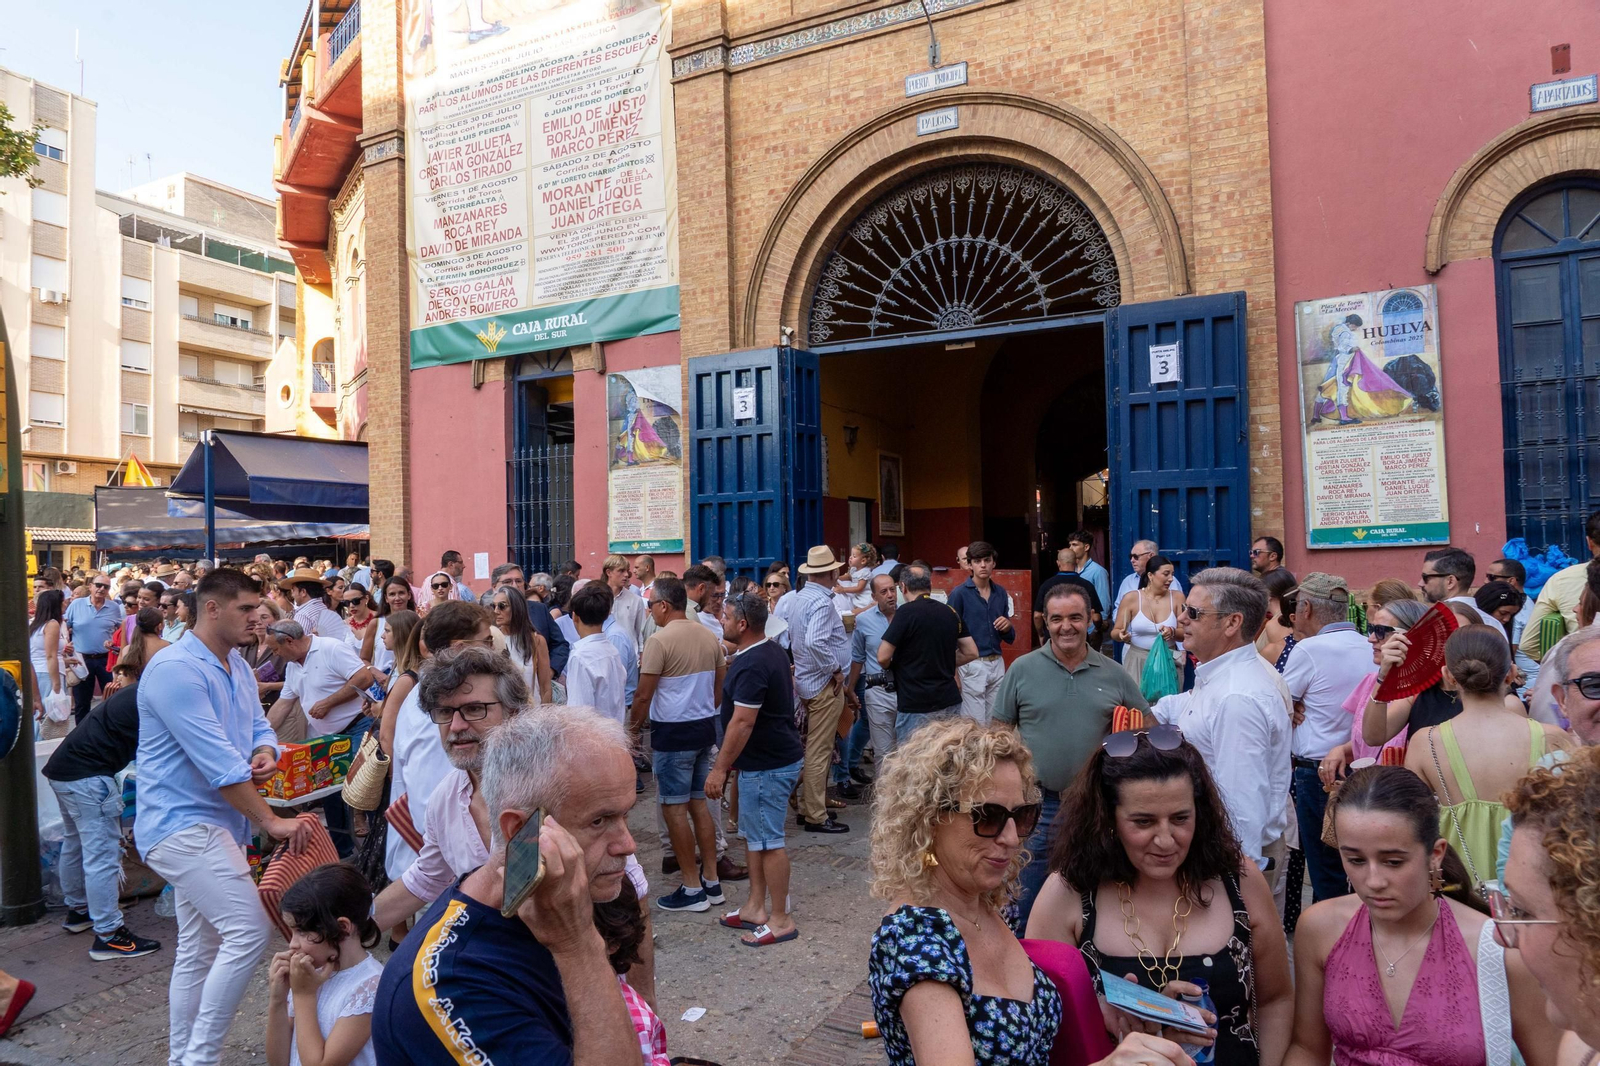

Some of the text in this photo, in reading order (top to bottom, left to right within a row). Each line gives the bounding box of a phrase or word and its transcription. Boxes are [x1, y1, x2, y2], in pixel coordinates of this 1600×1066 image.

[487, 65, 536, 84] MARCELINO
[539, 55, 574, 69] ACOSTA
[606, 32, 650, 49] CONDESA
[419, 101, 437, 115] PARA
[439, 96, 458, 107] LOS
[461, 82, 503, 103] ALUMNOS
[506, 78, 518, 89] DE
[521, 72, 538, 84] LAS
[542, 54, 602, 78] DIFERENTES
[605, 34, 658, 60] ESCUELAS
[547, 85, 583, 100] JUEVES
[615, 67, 644, 81] JULIO
[551, 105, 572, 116] JUAN
[574, 97, 602, 109] PEDRO
[604, 86, 642, 100] DOMECQ
[555, 93, 588, 105] Corrida
[605, 80, 630, 91] Toros
[1537, 83, 1591, 104] APARTADOS
[496, 104, 521, 115] JULIO
[543, 94, 646, 134] EMILIO DE JUSTO
[922, 114, 951, 129] PALCOS
[422, 130, 458, 143] Novillada
[477, 114, 518, 128] Picadores
[458, 132, 476, 142] LUIS
[479, 123, 511, 136] PEREDA
[547, 108, 643, 146] BORJA JIMÉNEZ
[426, 133, 511, 165] JAVIER ZULUETA
[551, 123, 639, 159] MARCO PÉREZ
[610, 140, 651, 156] AGOSTO
[419, 143, 523, 180] CRISTIAN GONZÁLEZ
[556, 165, 589, 176] Corrida
[606, 153, 630, 164] Toros
[561, 174, 586, 184] LORETO
[588, 167, 615, 178] CHARRO
[617, 158, 644, 170] SANTOS
[430, 160, 512, 191] CARLOS TIRADO
[616, 173, 653, 185] PUEBLA
[425, 190, 459, 203] VIERNES
[481, 176, 518, 189] AGOSTO
[437, 197, 464, 208] Corrida
[479, 188, 502, 197] Toros
[542, 176, 612, 204] MORANTE
[550, 182, 642, 216] DANIEL LUQUE
[434, 202, 508, 229] MANZANARES
[448, 196, 497, 211] TORREALTA
[551, 198, 642, 229] JUAN ORTEGA
[444, 219, 498, 241] ROCA REY
[550, 214, 648, 240] VENTA ONLINE DESDE
[595, 226, 623, 234] JUNIO
[420, 242, 452, 258] DAVID
[455, 238, 468, 252] DE
[472, 226, 522, 248] MIRANDA
[540, 226, 660, 254] WWW.TOROSPEREDA.COM
[425, 258, 464, 269] DOMINGO
[486, 244, 522, 258] AGOSTO
[434, 264, 463, 274] Corrida
[477, 256, 509, 266] Rejones
[585, 249, 602, 257] 281
[428, 287, 515, 311] DIEGO VENTURA
[429, 284, 471, 299] SERGIO
[474, 276, 513, 292] GALÁN
[470, 297, 518, 315] ROMERO
[512, 312, 587, 335] CAJA RURAL
[1363, 321, 1432, 339] HUELVA
[1159, 361, 1169, 375] 3
[740, 401, 747, 412] 3
[422, 926, 458, 989] Kappa
[445, 1018, 495, 1066] Kap
